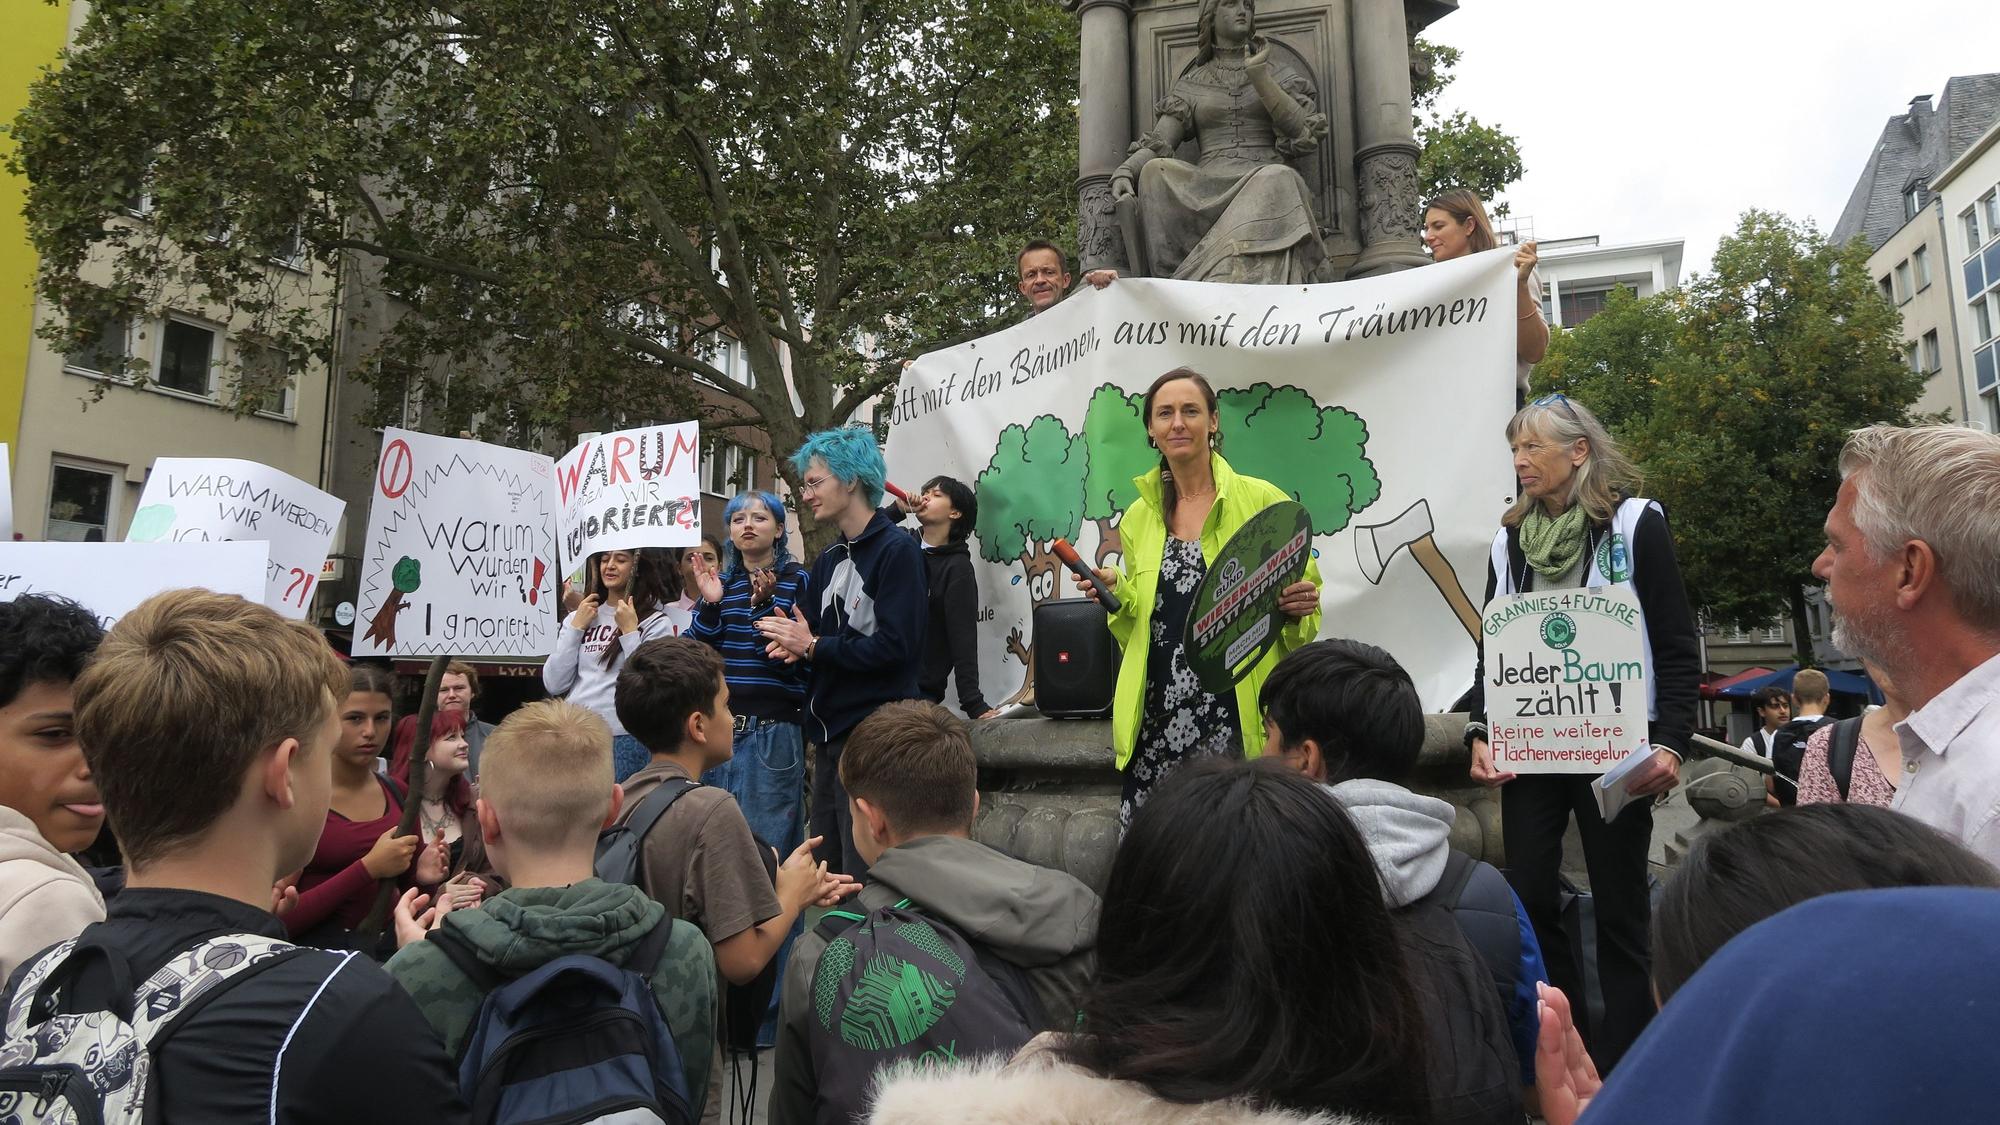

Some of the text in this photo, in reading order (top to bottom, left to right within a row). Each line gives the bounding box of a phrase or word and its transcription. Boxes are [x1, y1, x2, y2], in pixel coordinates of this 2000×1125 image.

[922, 372, 957, 414] mit
[960, 357, 1001, 402] den
[1010, 326, 1100, 386] Bäumen,
[1114, 319, 1168, 345] aus
[1178, 312, 1237, 348] mit
[1239, 304, 1301, 348] den
[1318, 296, 1489, 343] Träumen
[557, 428, 698, 508] WARUM
[169, 474, 270, 508] WARUM
[271, 493, 334, 537] WERDEN
[620, 481, 660, 503] WIR
[219, 502, 262, 531] WIR
[1196, 534, 1304, 634] WIESEN UND WALD
[1216, 570, 1243, 598] BUND
[1200, 605, 1240, 648] STATT
[1243, 550, 1301, 609] ASPHALT
[977, 606, 994, 622] ule
[499, 667, 537, 676] LYLY
[1492, 648, 1642, 687] Jeder Baum
[1553, 719, 1624, 738] weitere
[1492, 738, 1631, 766] Flächenversiegelun
